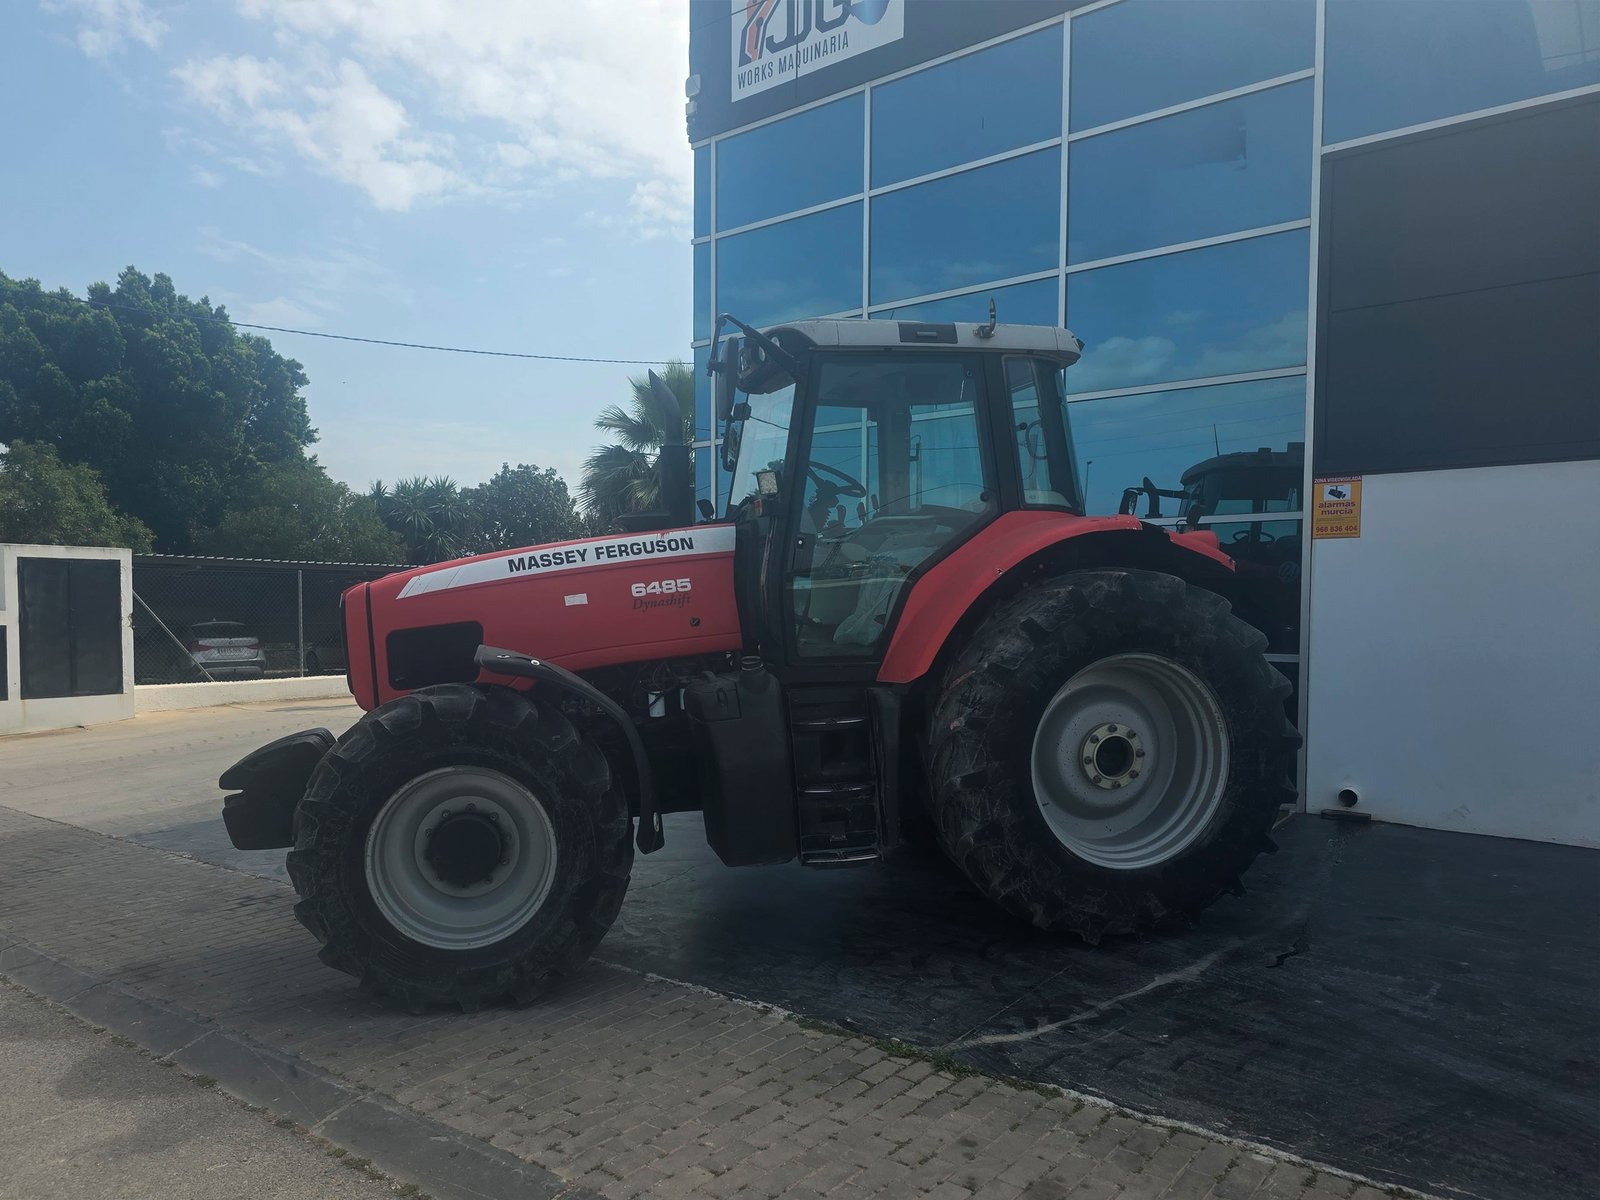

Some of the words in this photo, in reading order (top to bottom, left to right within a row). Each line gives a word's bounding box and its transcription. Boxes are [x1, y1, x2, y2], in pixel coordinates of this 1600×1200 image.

[737, 62, 774, 89] WORKS
[778, 31, 849, 75] MAQUINARIA
[1318, 501, 1356, 509] alarmas
[507, 549, 588, 573] MASSEY
[594, 537, 694, 561] FERGUSON
[631, 578, 692, 597] 6485
[632, 594, 691, 613] Dynashift
